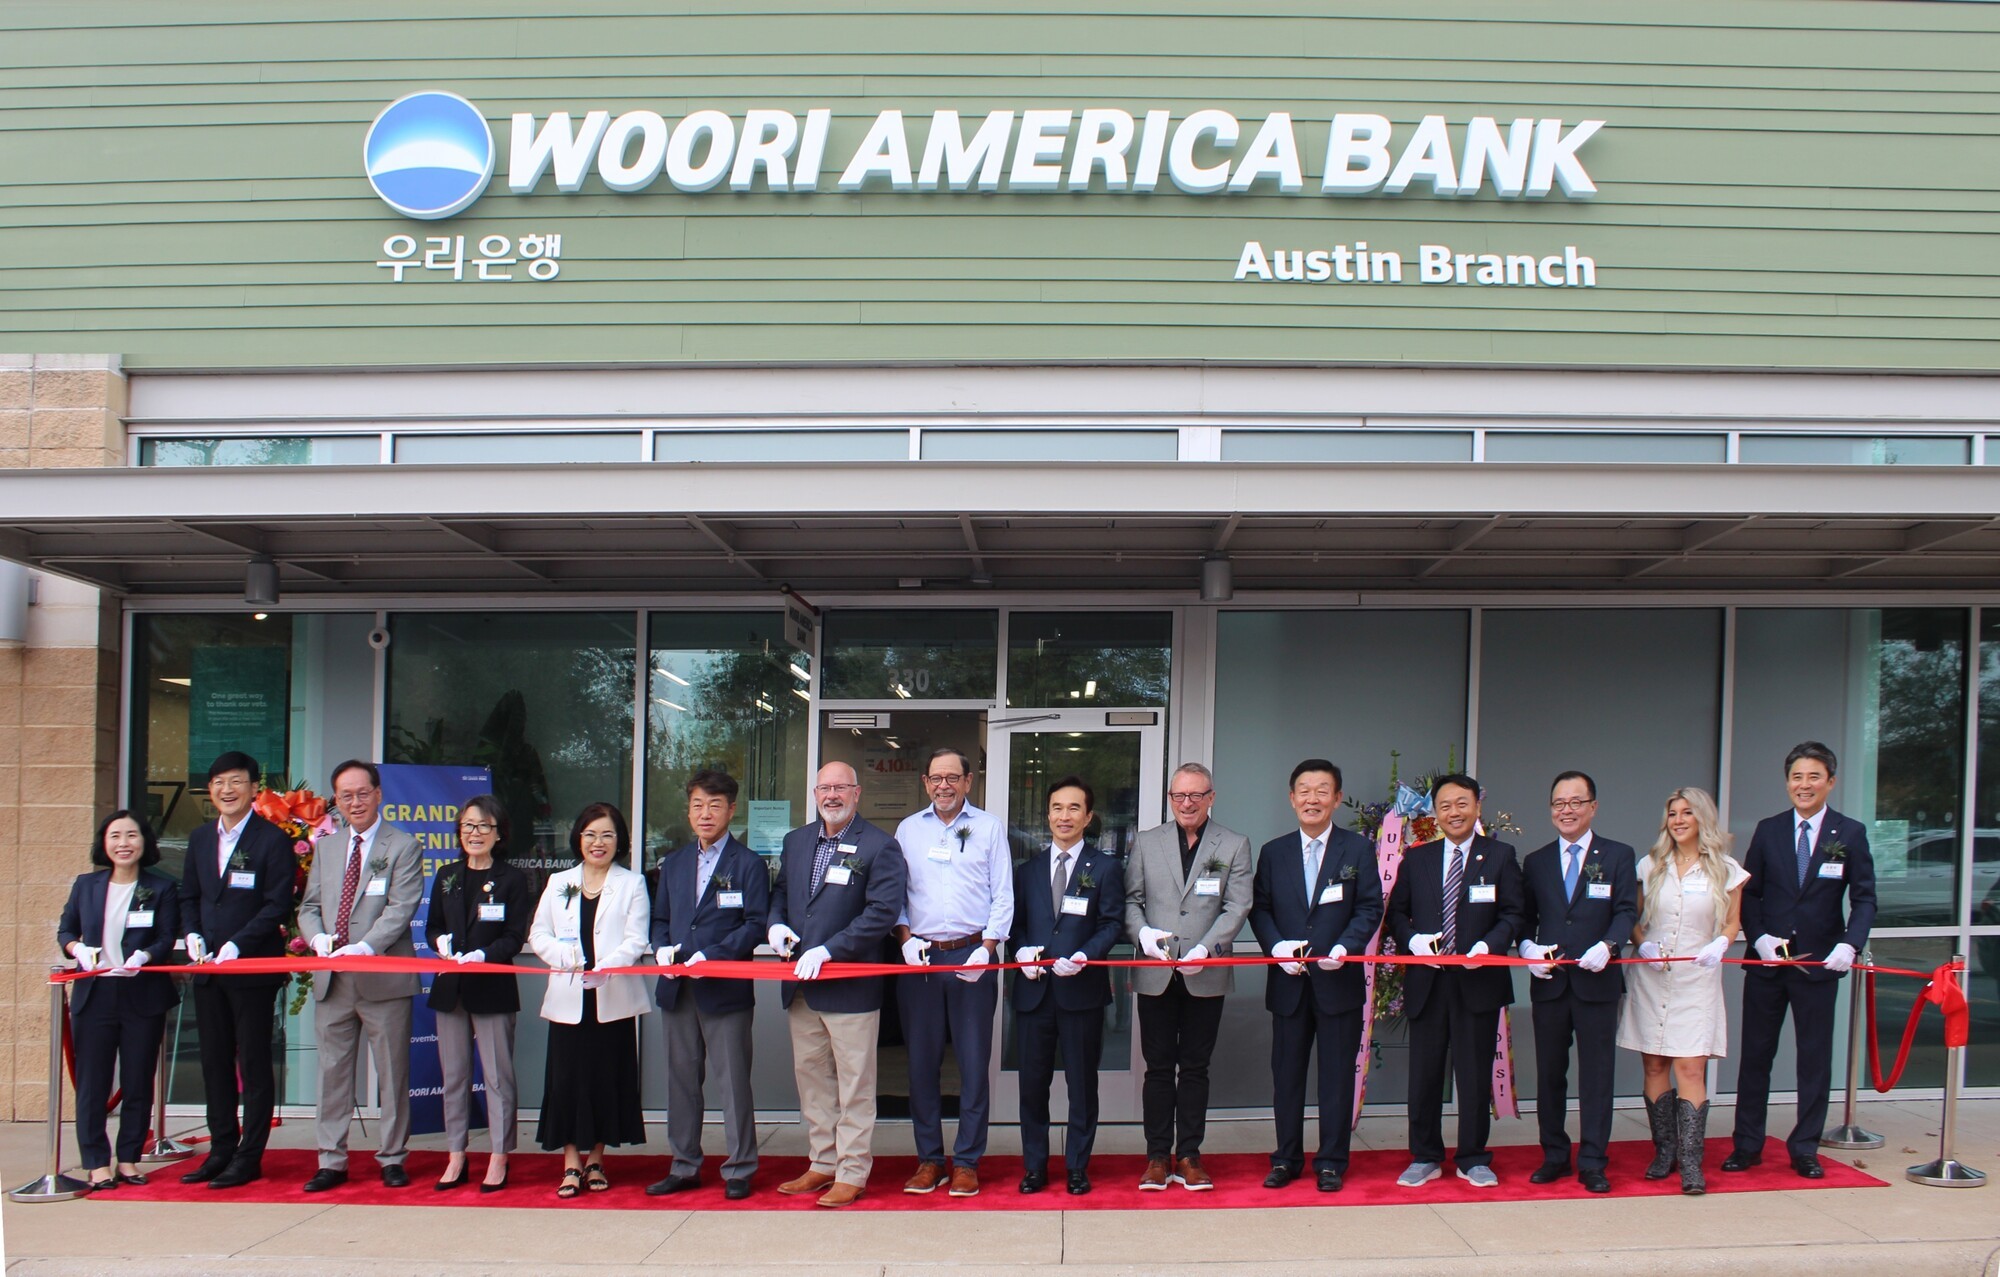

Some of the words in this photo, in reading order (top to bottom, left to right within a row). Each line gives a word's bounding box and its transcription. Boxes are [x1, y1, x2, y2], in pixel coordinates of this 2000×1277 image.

[508, 108, 831, 194] WOORI
[838, 108, 1303, 194] AMERICA
[1321, 113, 1606, 198] BANK
[376, 233, 562, 282] 우리은행
[1233, 241, 1401, 283] Austin
[1419, 244, 1597, 288] Branch
[887, 668, 930, 692] 330
[382, 803, 459, 822] GRAND
[544, 858, 575, 869] BANK
